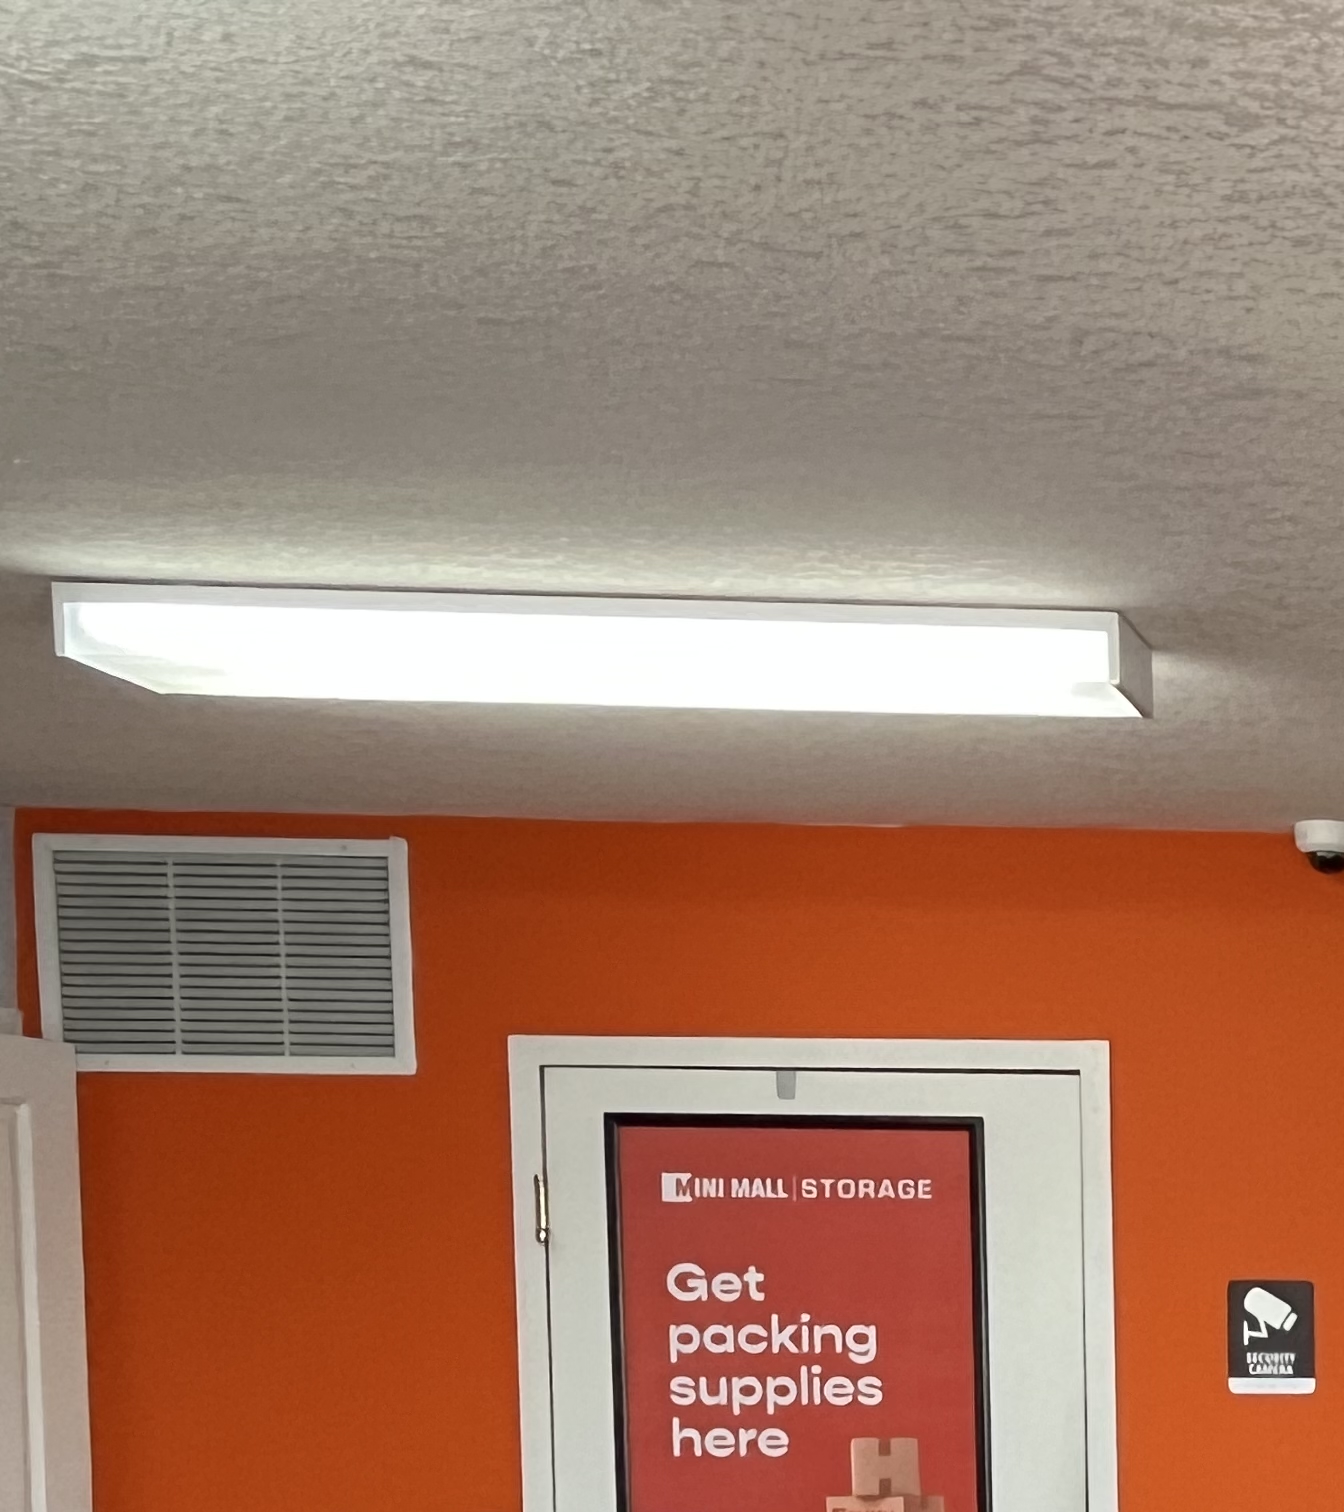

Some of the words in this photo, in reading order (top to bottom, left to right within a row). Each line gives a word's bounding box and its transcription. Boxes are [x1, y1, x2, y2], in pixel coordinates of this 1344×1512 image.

[673, 1176, 725, 1200] MINI
[730, 1177, 789, 1198] MALL
[801, 1178, 933, 1199] STORAGE
[666, 1262, 766, 1302] Get
[668, 1313, 878, 1364] packing
[669, 1364, 884, 1416] supplies
[672, 1416, 789, 1458] here
